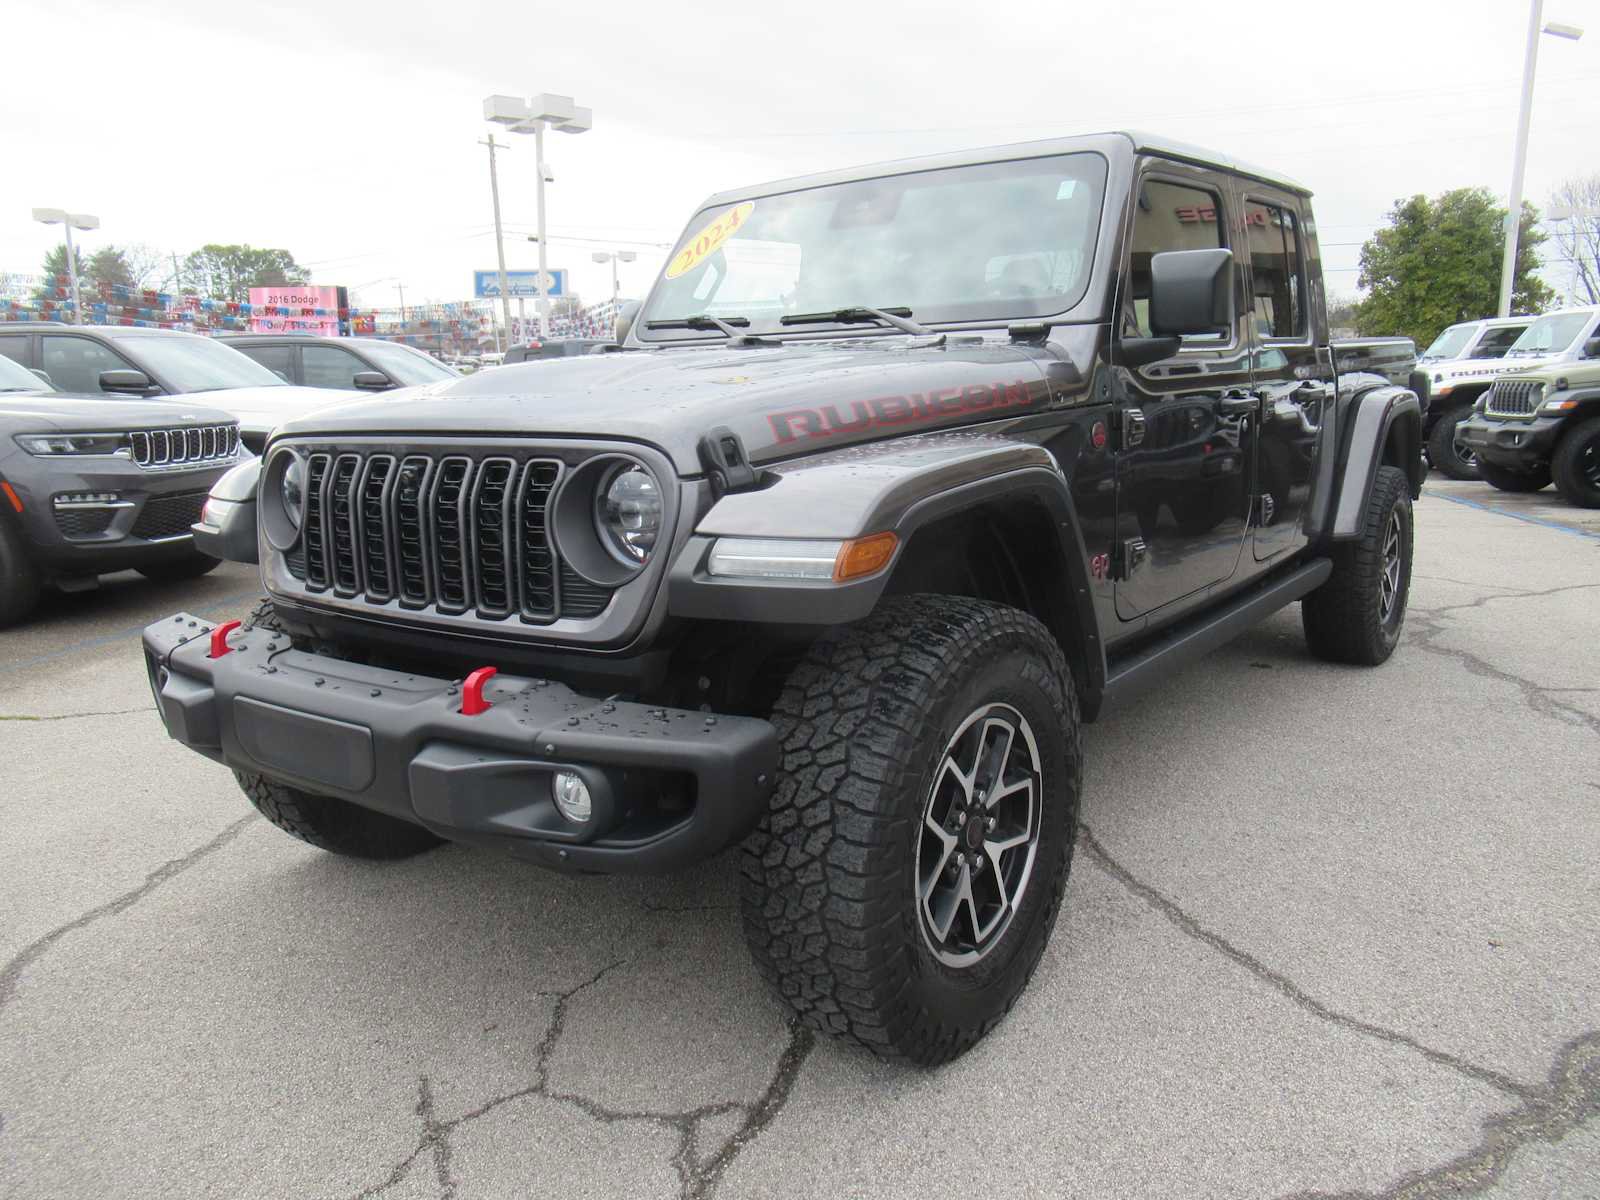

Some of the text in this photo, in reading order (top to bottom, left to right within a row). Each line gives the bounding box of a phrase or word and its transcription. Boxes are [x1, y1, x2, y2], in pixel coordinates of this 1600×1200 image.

[680, 207, 739, 271] 2024
[268, 295, 320, 305] 2016 Dodge
[1451, 367, 1525, 377] RUBICO
[767, 379, 1033, 445] RUBICON
